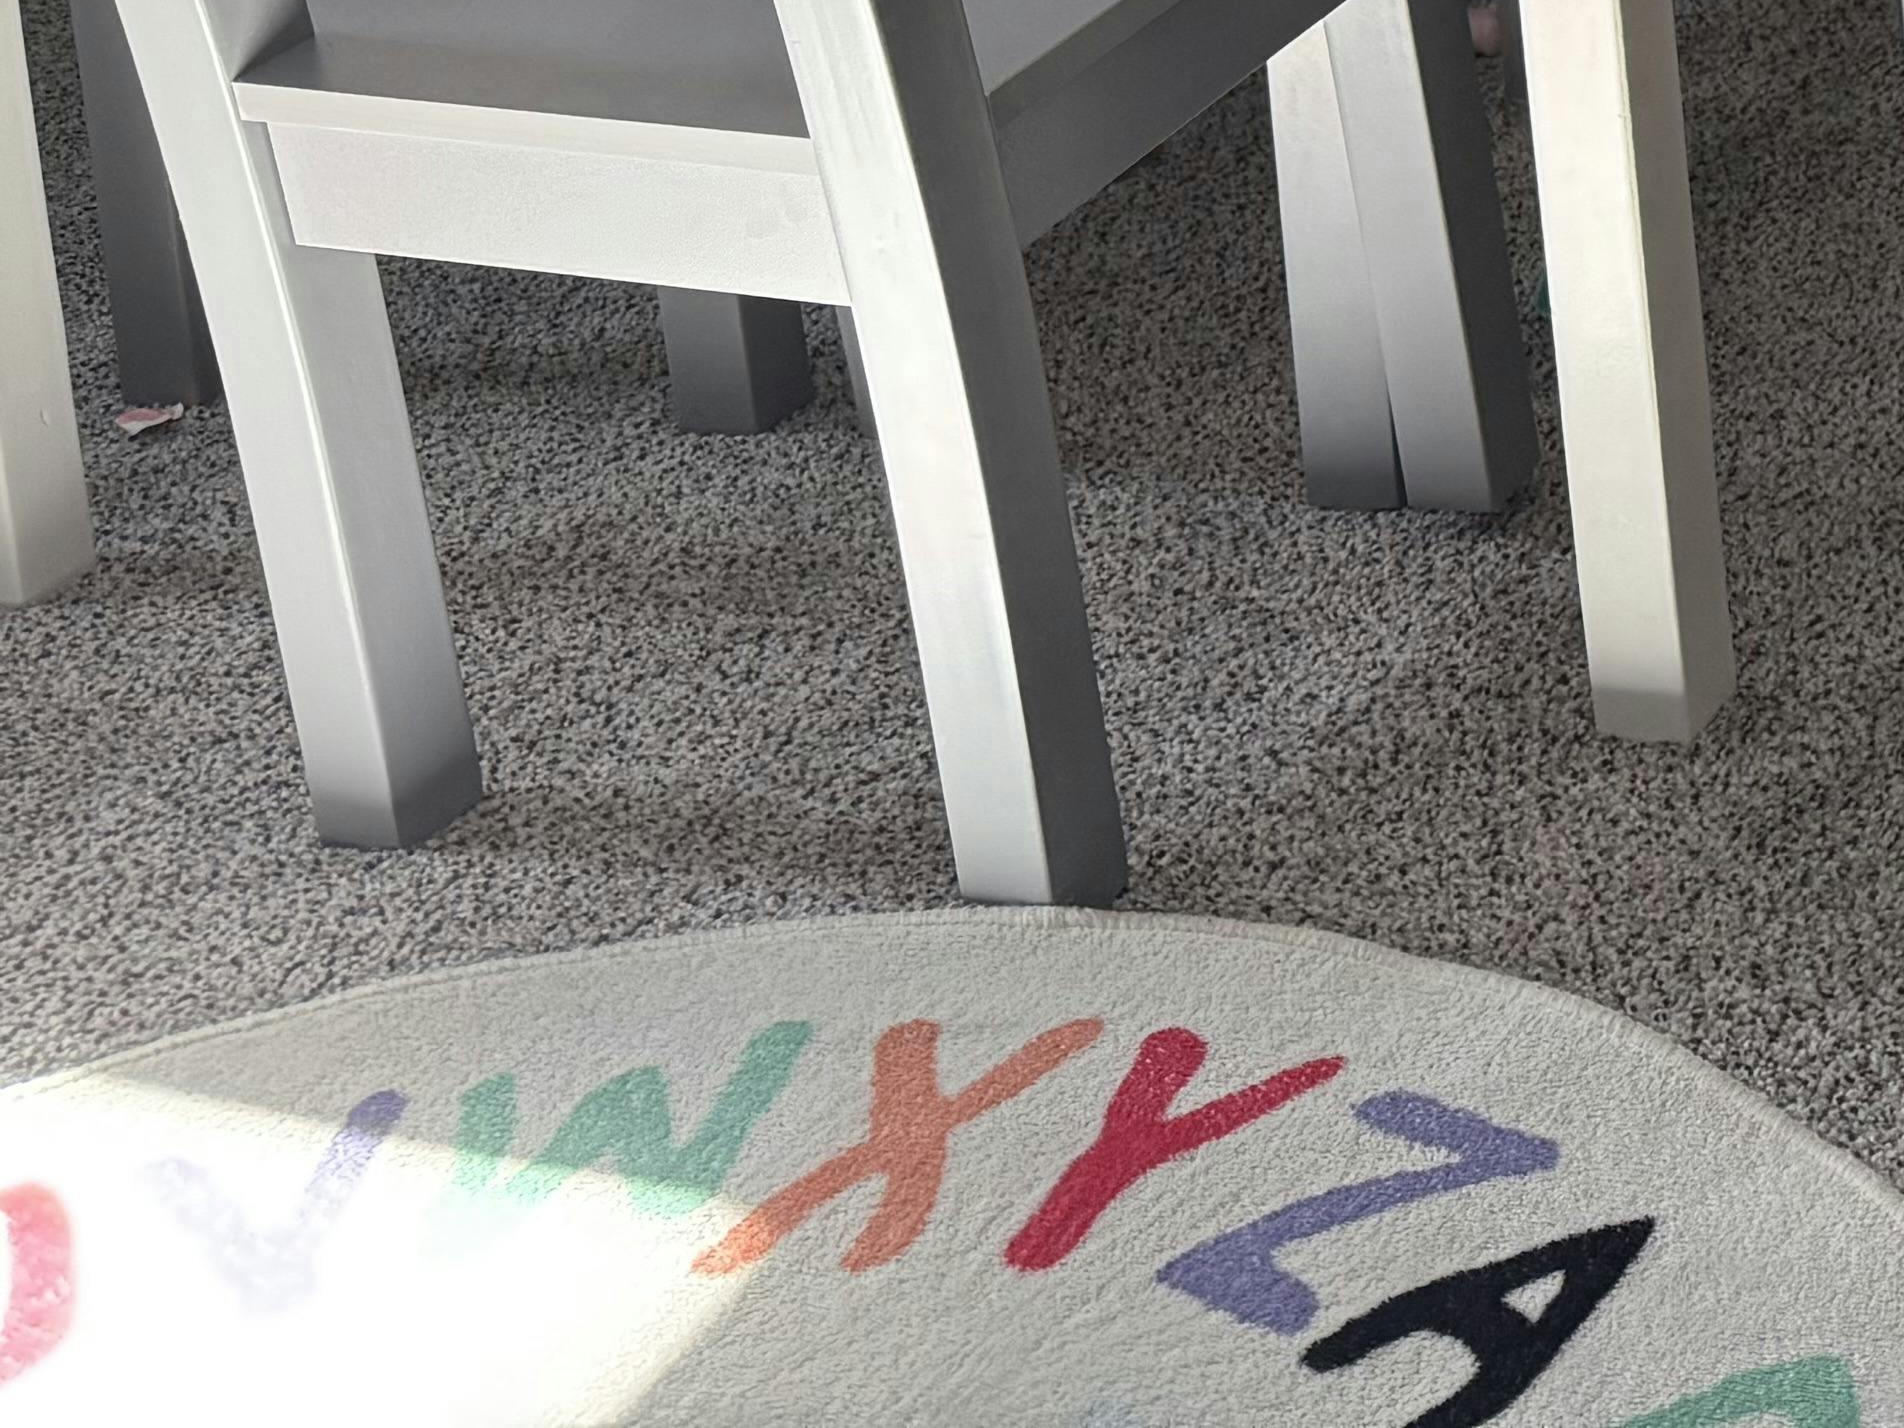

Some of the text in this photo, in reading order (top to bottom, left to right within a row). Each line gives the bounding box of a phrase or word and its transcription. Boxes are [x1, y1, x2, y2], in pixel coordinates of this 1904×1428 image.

[692, 1019, 1103, 1275] X
[1003, 1027, 1346, 1271] Y
[1156, 1087, 1561, 1336] Z
[1300, 1215, 1656, 1428] A
